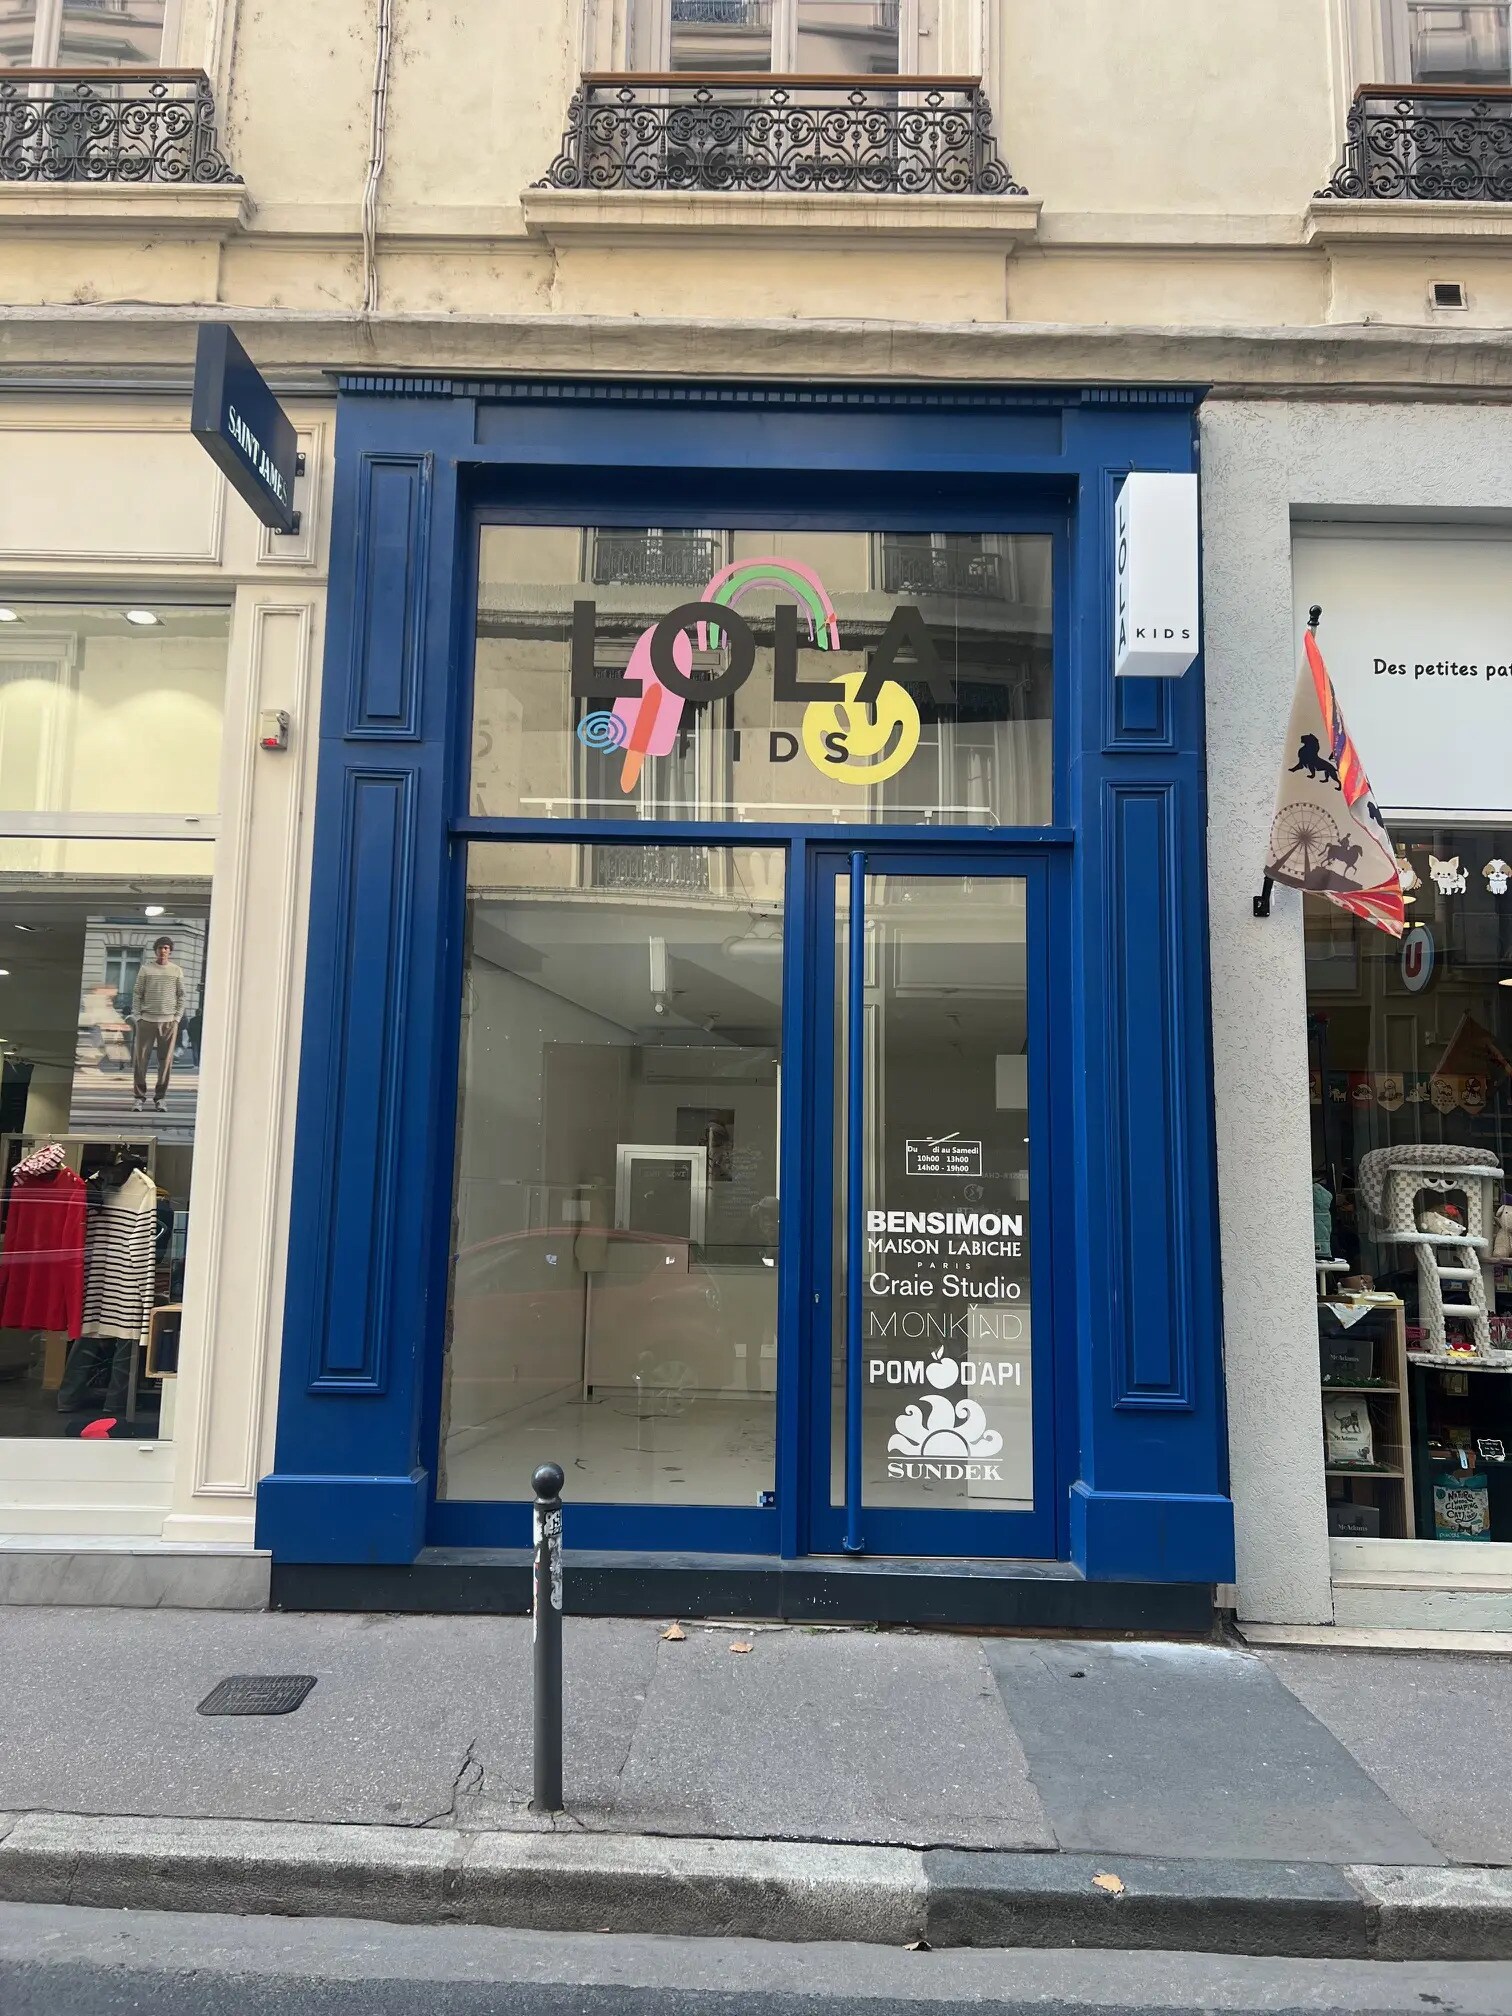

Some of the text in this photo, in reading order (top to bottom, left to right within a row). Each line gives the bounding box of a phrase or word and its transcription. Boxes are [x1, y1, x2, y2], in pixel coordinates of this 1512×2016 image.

[228, 405, 288, 508] SAINT JAMES
[1117, 504, 1128, 657] LOLA
[1136, 628, 1190, 639] KIDS
[571, 600, 957, 704] LOLA
[1373, 658, 1406, 675] Des
[1414, 660, 1478, 680] petites
[907, 1145, 918, 1153] Du
[952, 1146, 979, 1155] Samedi
[946, 1155, 969, 1163] 13h00
[867, 1210, 1023, 1236] BENSIMON
[867, 1238, 1022, 1257] MAISON LABICHE
[917, 1261, 971, 1270] PARIS
[869, 1272, 1021, 1299] Craie Studio
[887, 1462, 1004, 1481] SUNDEK
